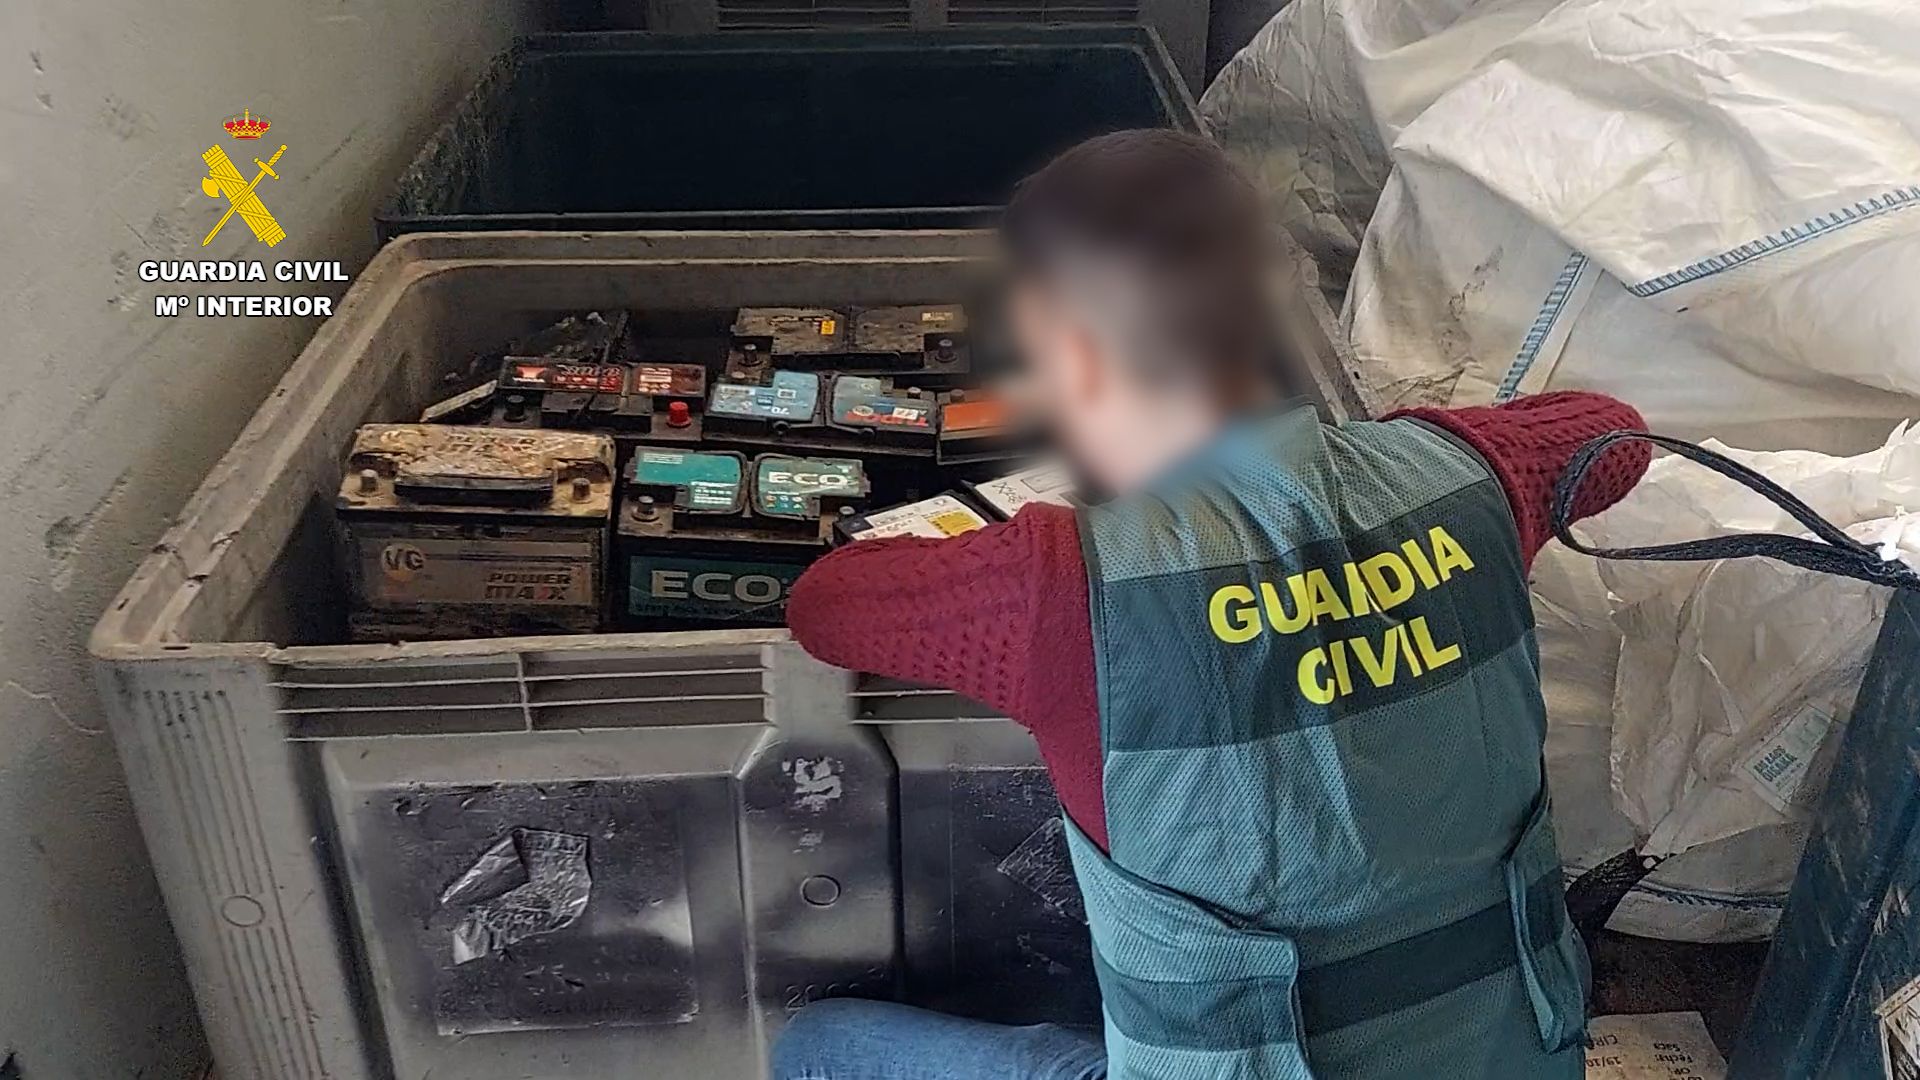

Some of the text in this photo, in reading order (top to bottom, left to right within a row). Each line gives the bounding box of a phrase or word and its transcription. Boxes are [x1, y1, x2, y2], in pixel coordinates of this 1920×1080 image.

[768, 471, 849, 487] ECO
[487, 572, 572, 585] POWER
[650, 569, 781, 604] ECO
[1296, 615, 1462, 706] CIVIL
